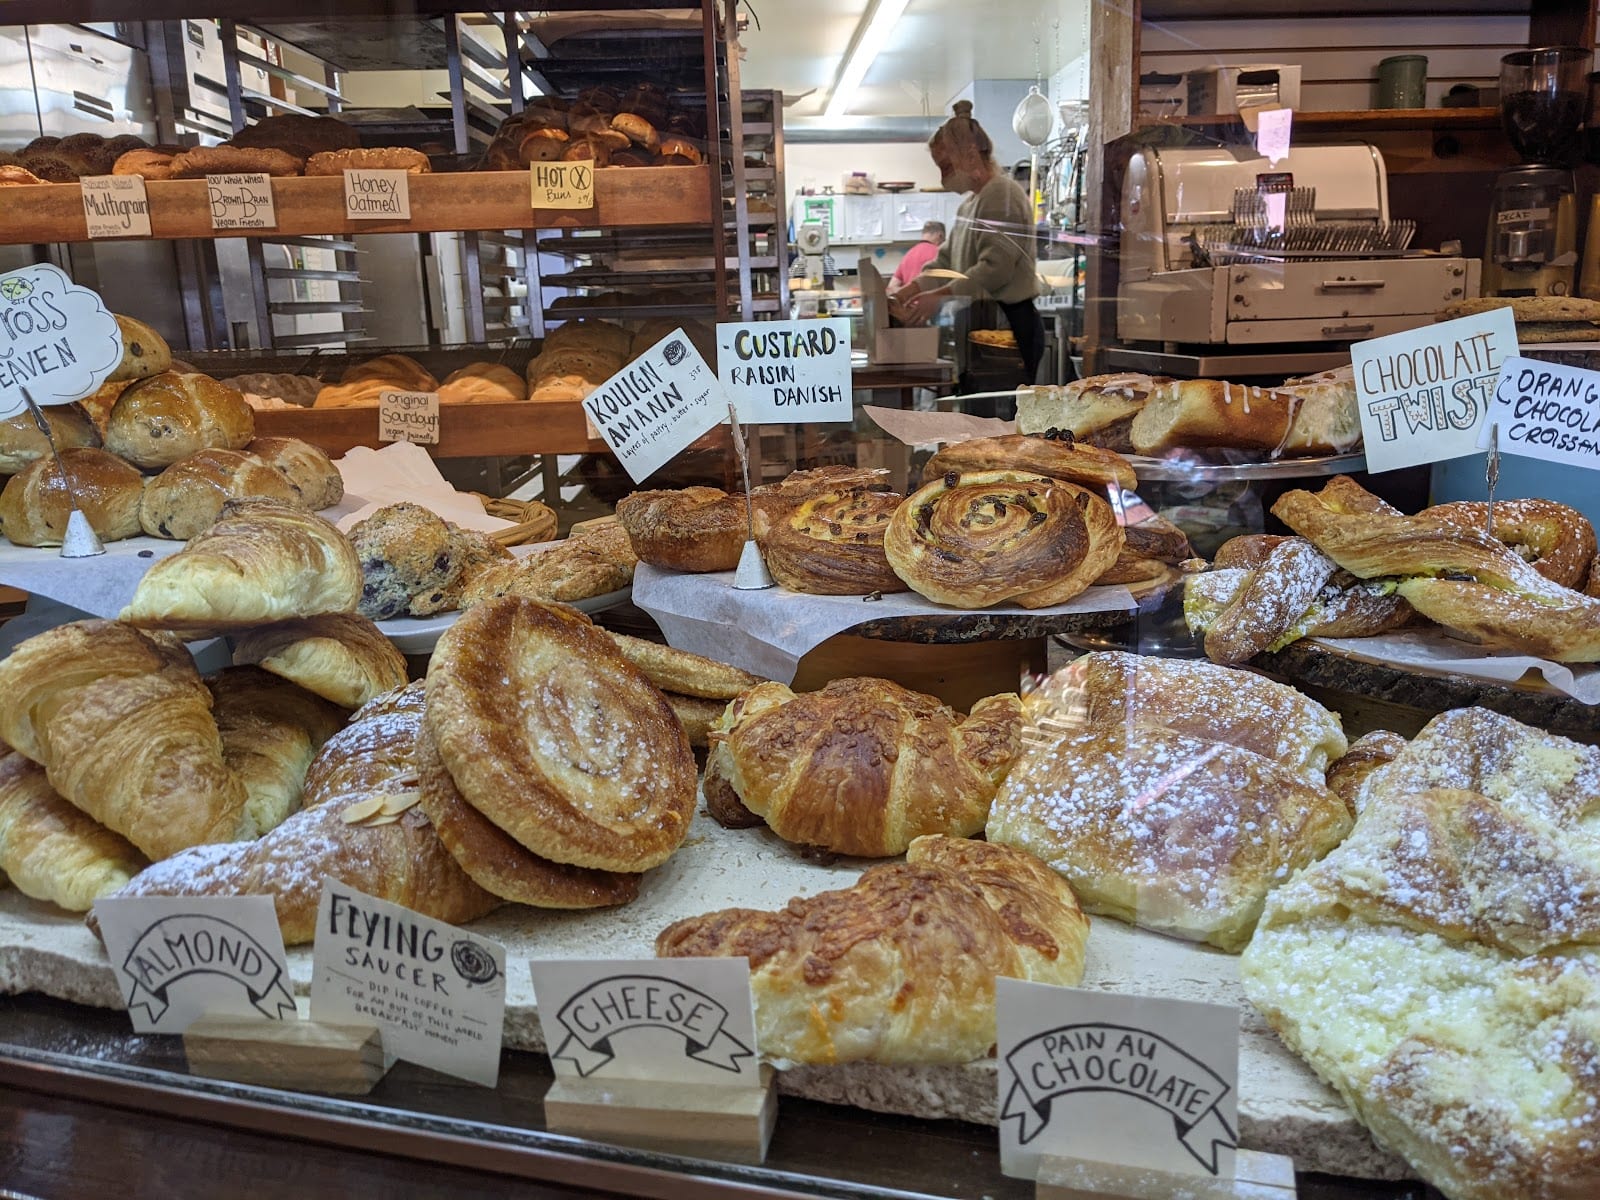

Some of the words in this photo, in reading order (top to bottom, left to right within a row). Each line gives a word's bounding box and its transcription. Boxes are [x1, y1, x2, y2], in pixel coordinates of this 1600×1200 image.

[243, 174, 265, 184] Wheat
[350, 172, 397, 201] Honey
[537, 166, 567, 188] HOT
[84, 192, 149, 229] Multigrain
[348, 193, 401, 213] Oatmeal
[545, 189, 572, 203] Buns
[0, 337, 77, 389] EAVEN
[731, 365, 795, 385] RAISIN
[1361, 332, 1501, 395] CHOCOLATE
[387, 393, 429, 410] Original
[773, 385, 842, 407] DANISH
[1517, 369, 1600, 405] ORANG
[381, 407, 440, 432] Sourdough
[607, 382, 683, 448] AMANN
[1368, 372, 1501, 442] TWIST
[1508, 422, 1600, 456] CROISSAN
[330, 893, 444, 962] FLYING
[135, 930, 263, 985] ALMOND
[346, 946, 450, 997] SAUCER
[415, 996, 454, 1017] COFFEE
[573, 986, 713, 1033] CHEESE
[455, 1025, 483, 1041] WORLD
[1043, 1031, 1106, 1060] PAIN
[1032, 1055, 1211, 1115] CHOCOLATE
